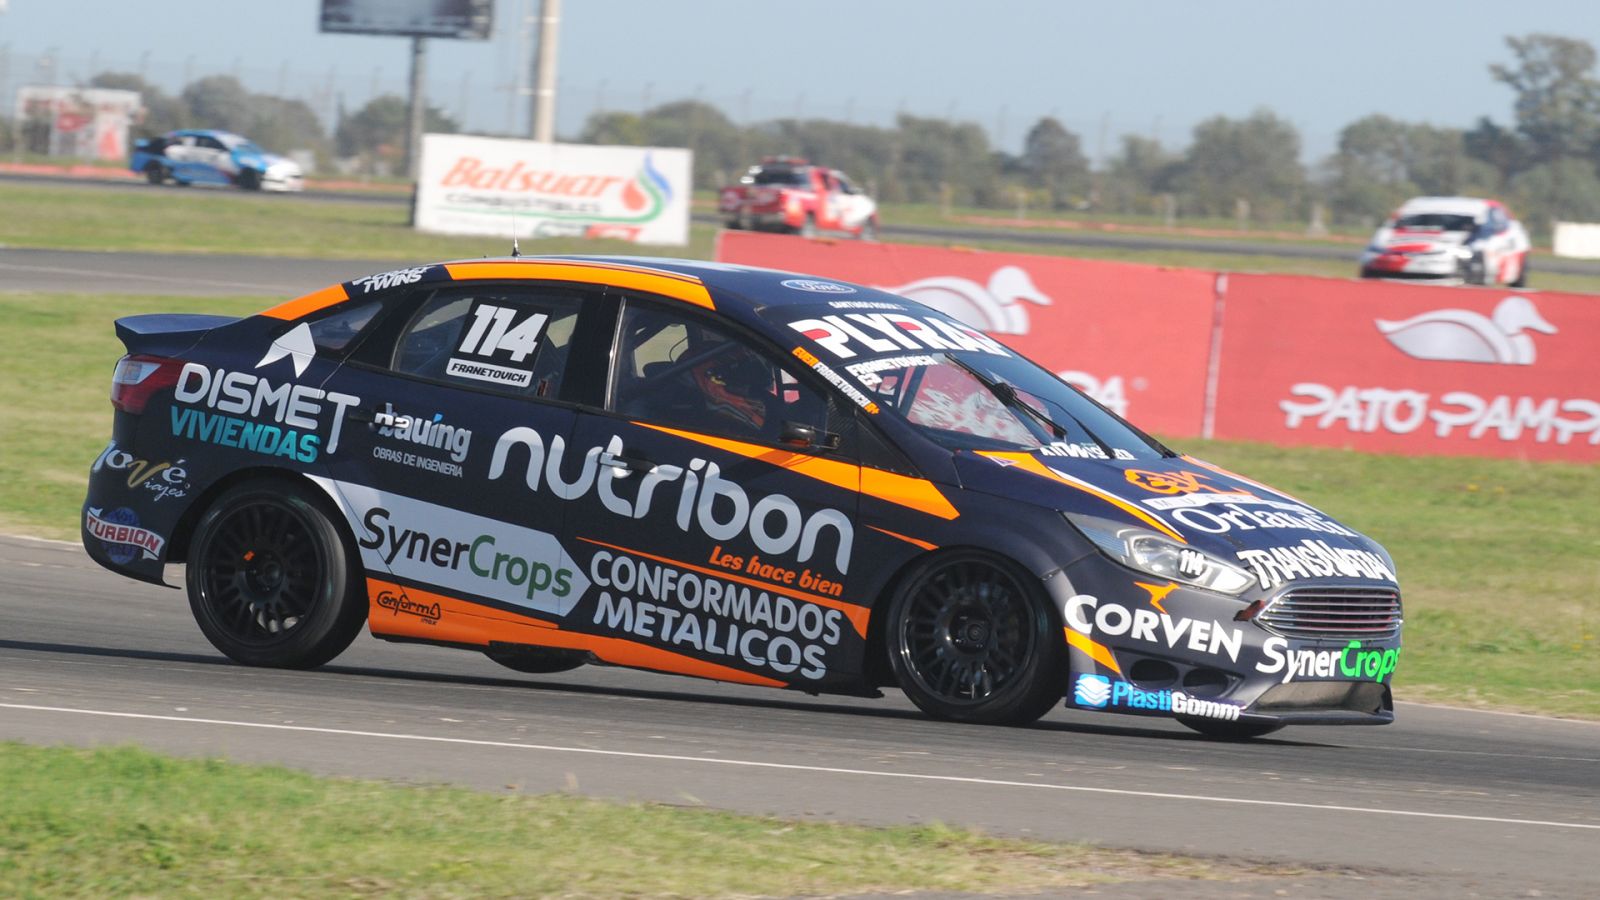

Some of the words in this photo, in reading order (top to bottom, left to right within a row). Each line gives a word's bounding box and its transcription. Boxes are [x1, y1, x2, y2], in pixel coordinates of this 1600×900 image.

[440, 156, 624, 197] Balsuar
[364, 273, 422, 293] TWINS
[458, 304, 548, 362] 114
[451, 363, 528, 383] FRANETOVICH
[171, 405, 321, 463] VIVIENDAS
[174, 361, 361, 455] DISMET
[1279, 381, 1431, 434] PATO
[1430, 391, 1600, 445] PAMP
[373, 446, 403, 463] OBRAS
[403, 453, 416, 467] DE
[416, 456, 463, 478] INGENIERIA
[488, 426, 854, 576] nutribon
[88, 516, 161, 551] TURBION
[359, 507, 573, 600] SynerCrops
[590, 551, 842, 646] CONFORMADOS
[709, 545, 743, 572] Les
[746, 553, 795, 585] hace
[799, 572, 844, 597] bien
[593, 592, 826, 680] METALICOS
[1064, 594, 1243, 663] CORVEN
[1113, 682, 1240, 721] PlastiGomm
